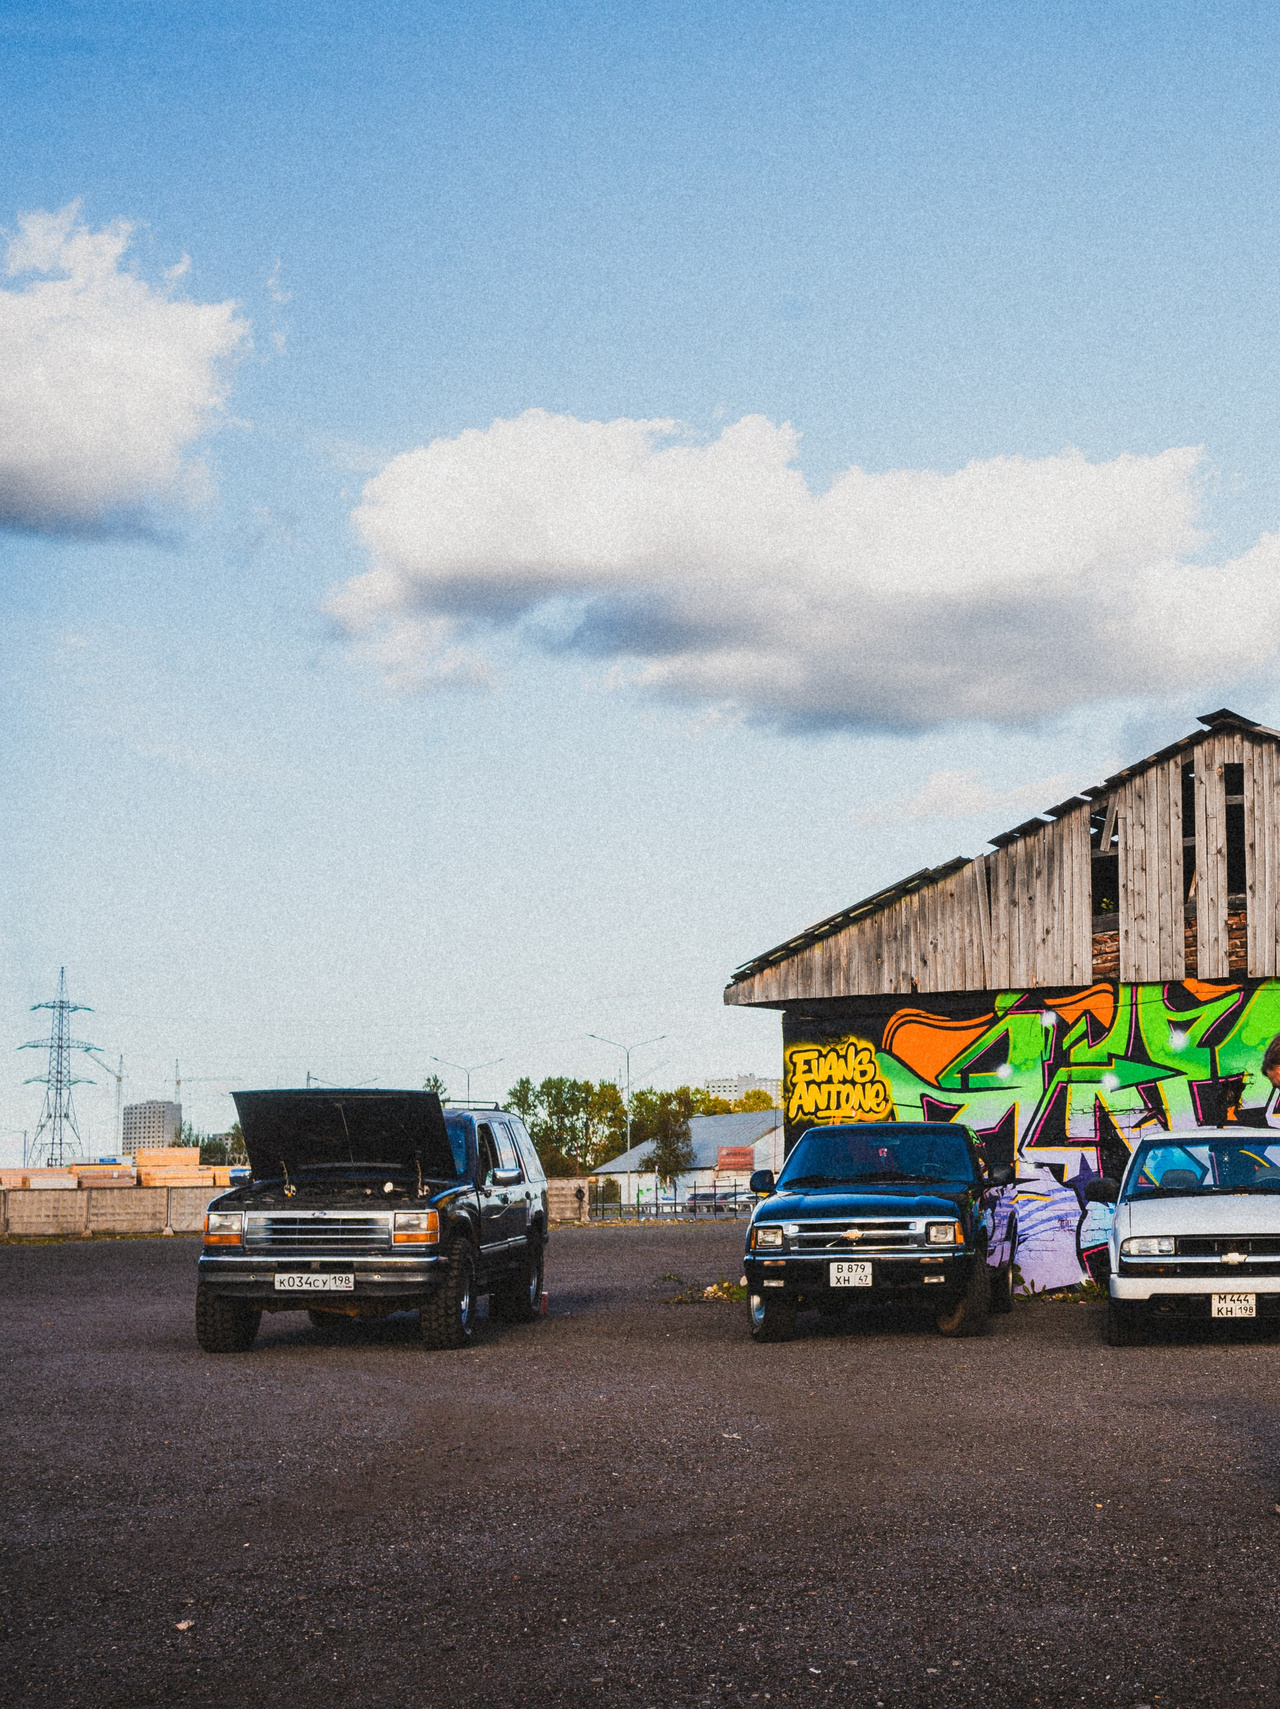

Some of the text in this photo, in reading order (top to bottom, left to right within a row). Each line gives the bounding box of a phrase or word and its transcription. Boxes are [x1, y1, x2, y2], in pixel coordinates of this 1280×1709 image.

[836, 1263, 866, 1274] В 879
[279, 1275, 351, 1289] К034СУ 198
[835, 1274, 869, 1286] ХН 47
[1218, 1294, 1250, 1304] М 444
[1216, 1305, 1254, 1316] КН 198
